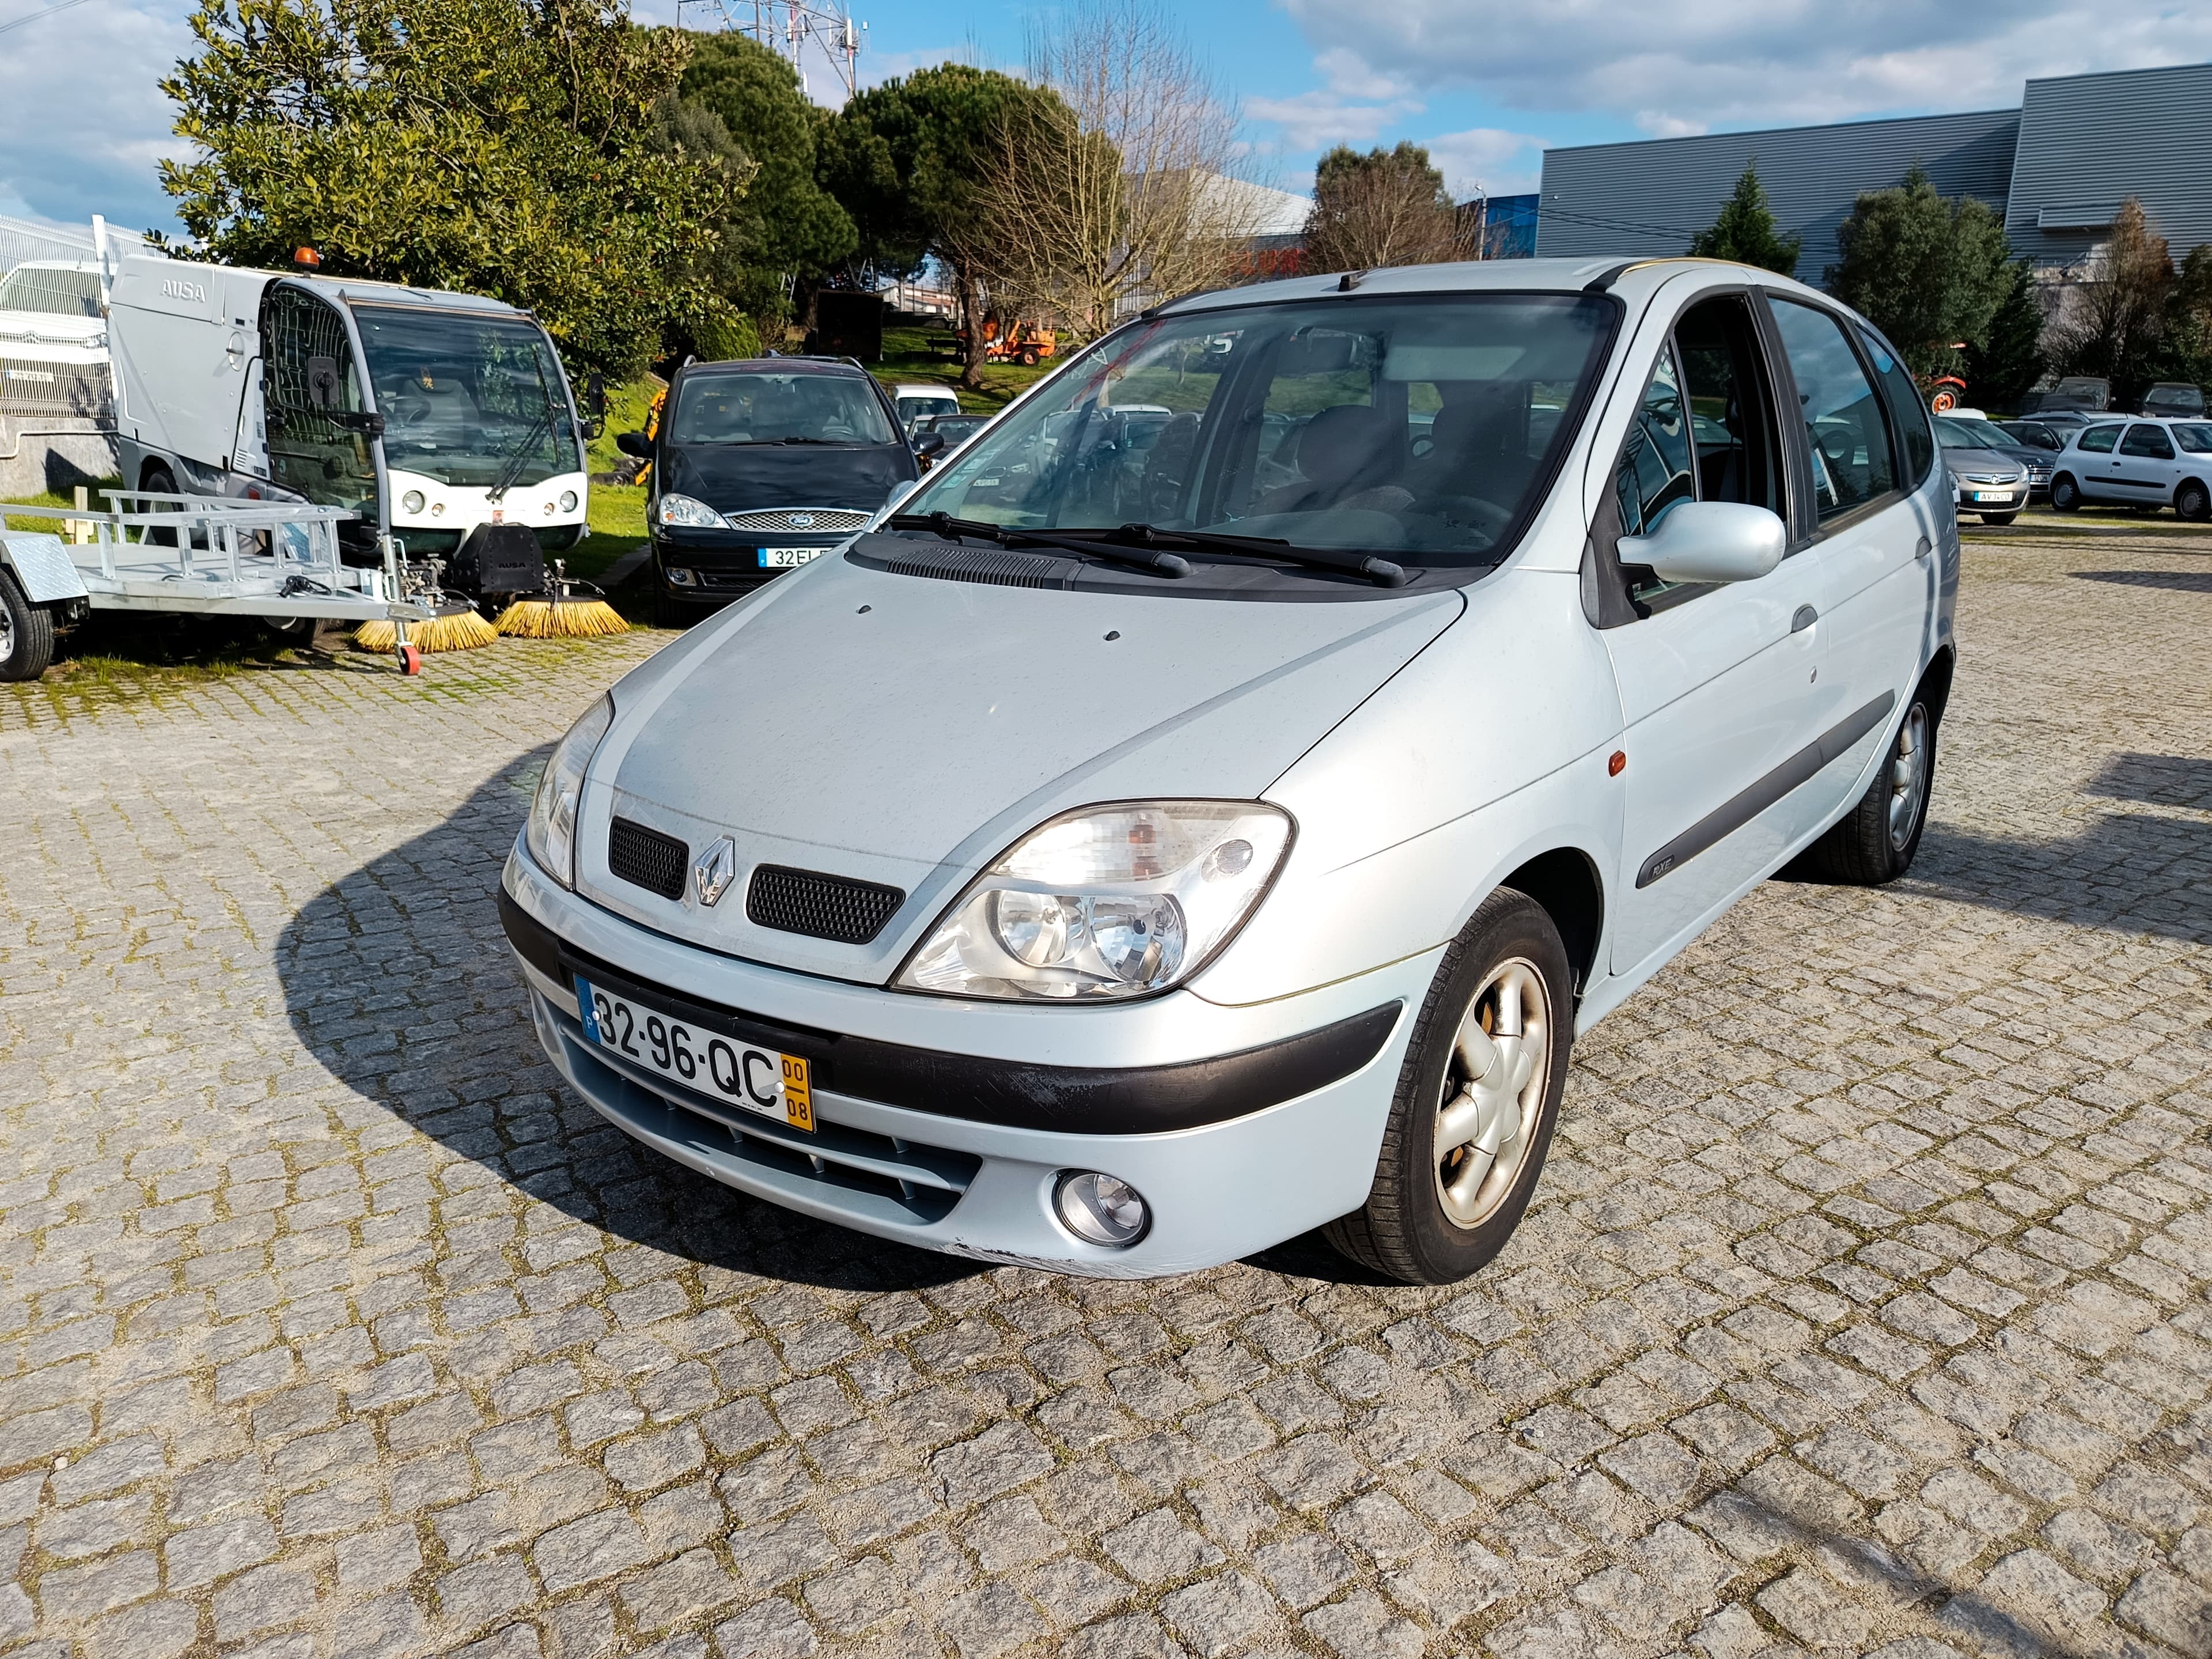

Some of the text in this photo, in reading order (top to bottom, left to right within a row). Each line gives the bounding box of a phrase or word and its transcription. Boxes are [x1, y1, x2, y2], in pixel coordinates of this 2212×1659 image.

[161, 279, 206, 302] AUSA
[1652, 858, 1672, 878] RXE
[585, 1015, 593, 1029] P
[782, 1059, 804, 1082] 00
[787, 1098, 808, 1121] 08
